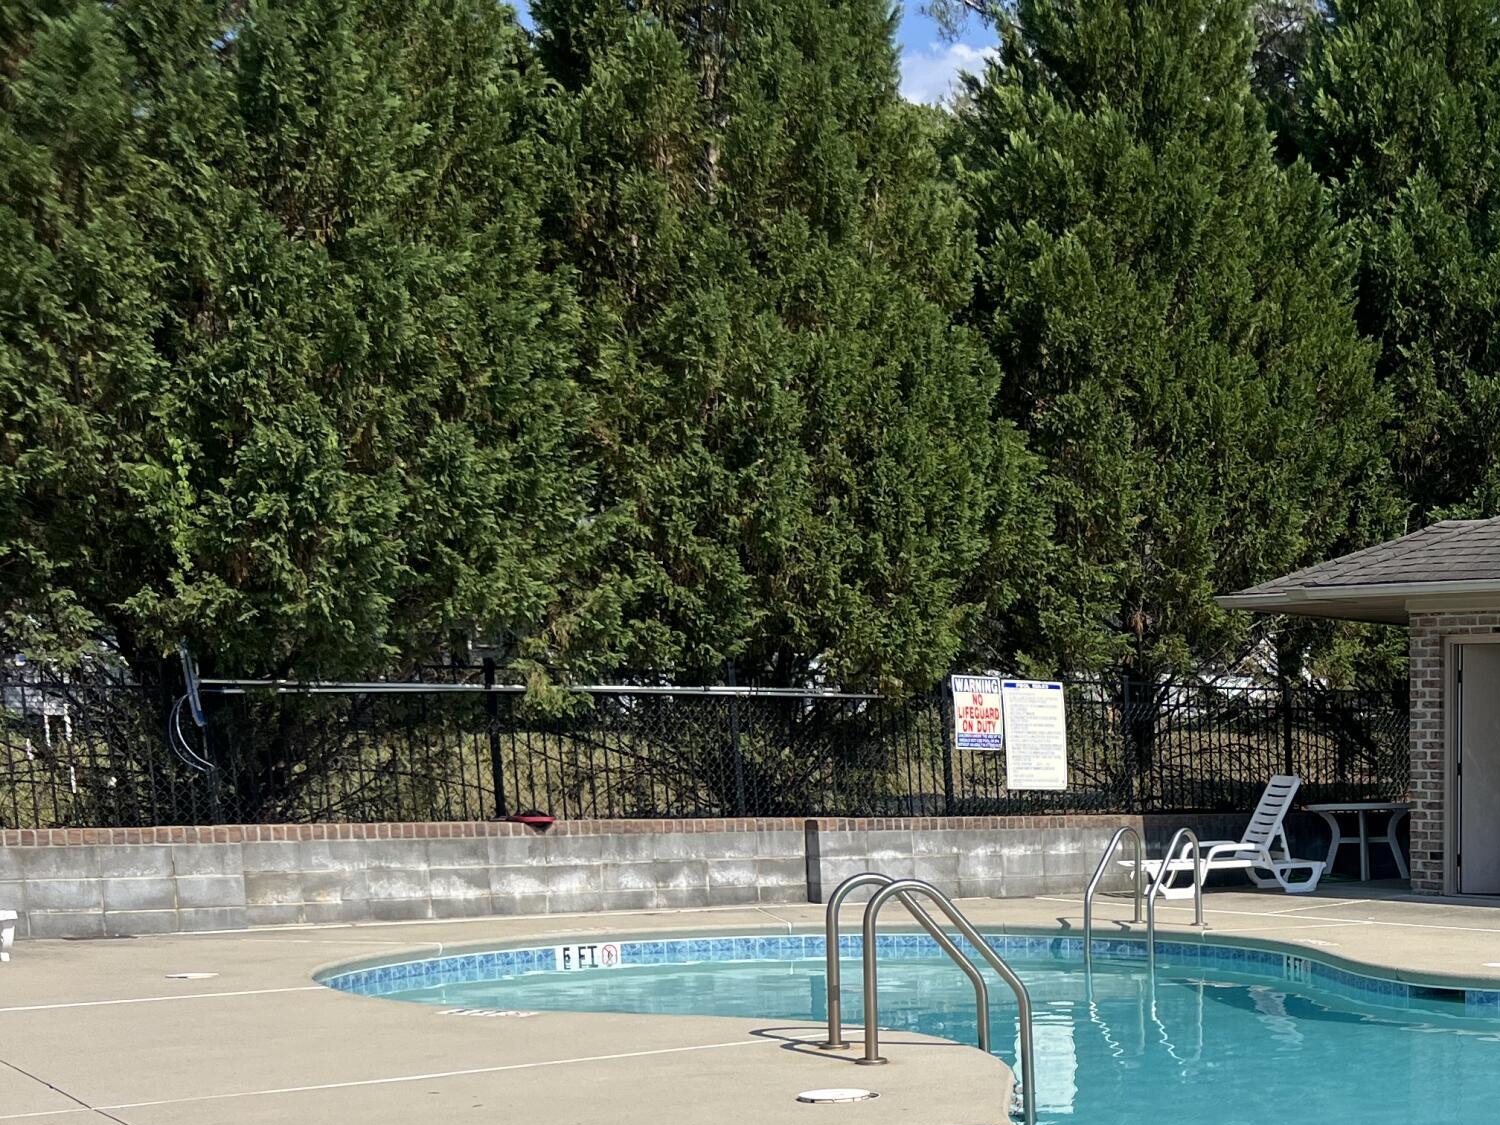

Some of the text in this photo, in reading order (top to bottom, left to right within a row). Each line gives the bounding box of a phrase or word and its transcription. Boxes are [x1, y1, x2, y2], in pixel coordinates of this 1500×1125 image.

[955, 678, 998, 693] WARNING
[972, 694, 983, 706] NO
[958, 707, 999, 720] LIFEGUARD
[962, 721, 997, 733] ON DUTY
